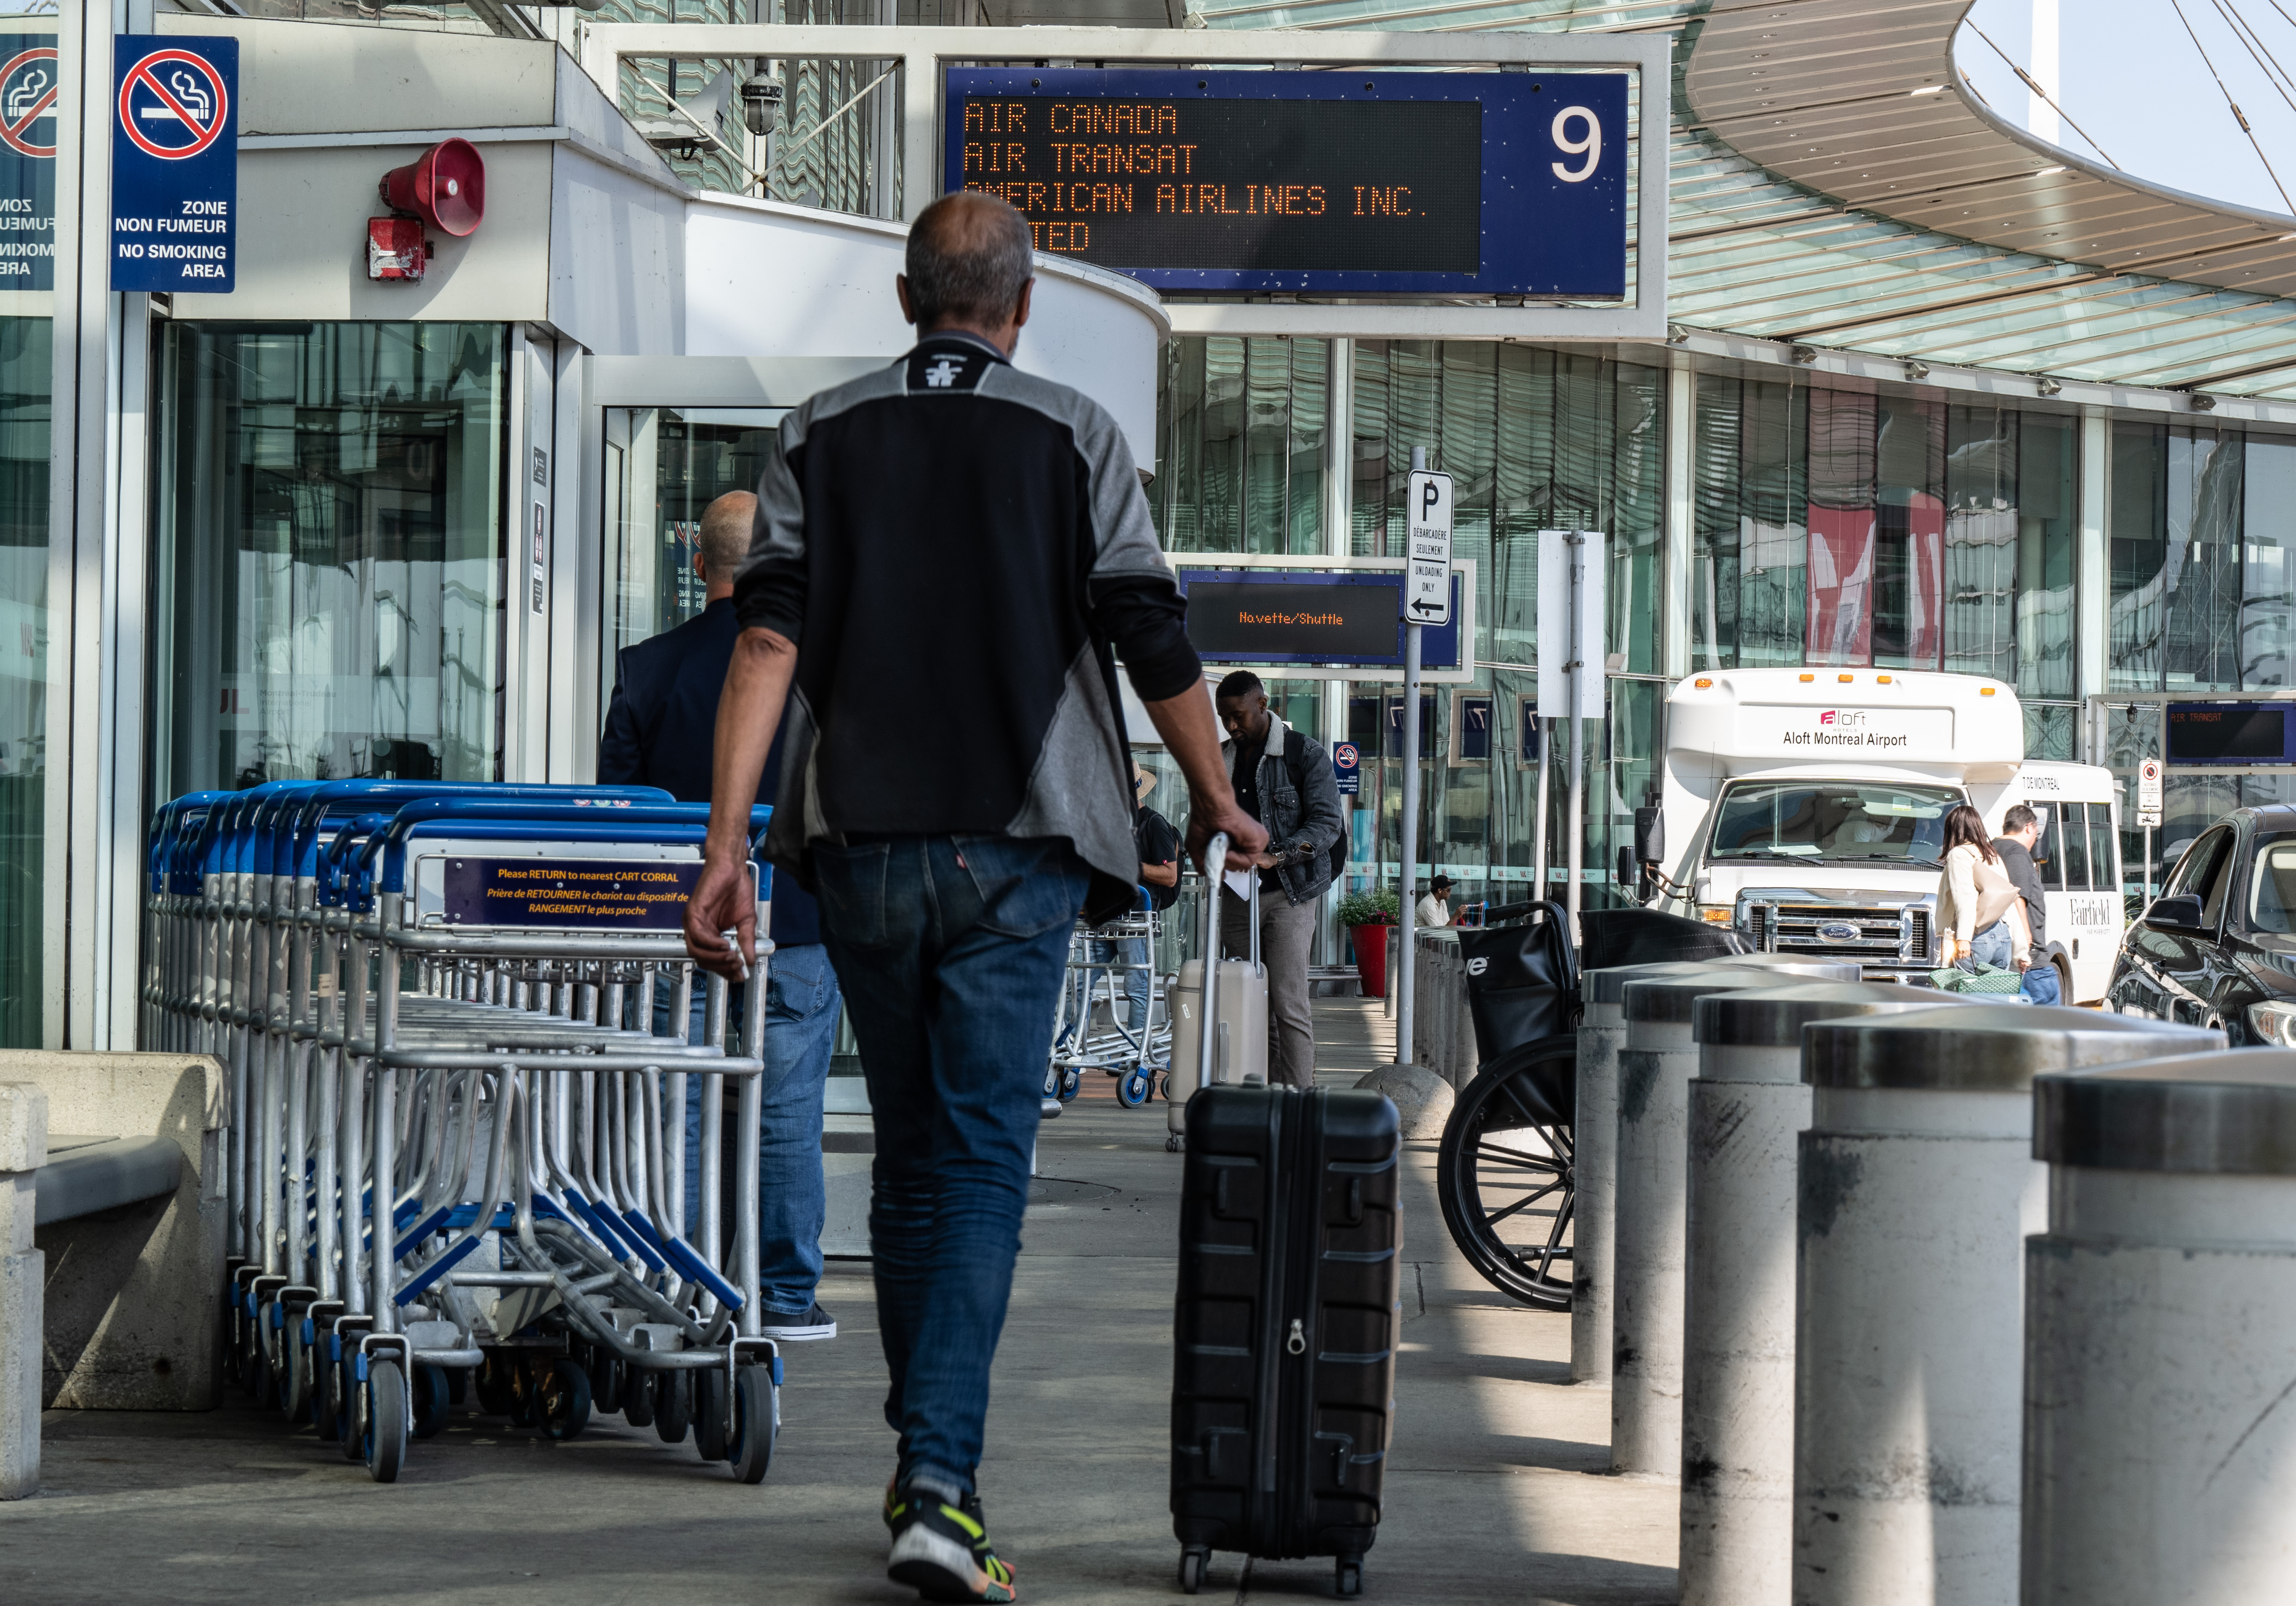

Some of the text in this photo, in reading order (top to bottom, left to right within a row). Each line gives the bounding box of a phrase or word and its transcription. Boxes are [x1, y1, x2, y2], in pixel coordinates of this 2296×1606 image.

[965, 103, 1176, 133] AIR CANADA
[1552, 106, 1601, 182] 9
[965, 143, 1197, 173] AIR TRANSAT
[1157, 184, 1325, 214] AIRLINES
[1353, 187, 1425, 215] INC.
[182, 201, 227, 215] ZONE
[116, 218, 226, 233] NON FUMEUR
[1028, 222, 1088, 251] TED
[119, 244, 226, 259] NO SMOKING
[182, 264, 225, 278] AREA
[1423, 482, 1439, 521] P
[1414, 525, 1447, 540] DÉBARCADÈRE
[1416, 544, 1443, 555] SEULEMENT
[1415, 565, 1442, 577] UNLOADING
[1422, 582, 1434, 592] ONLY
[1240, 612, 1342, 625] Navette/Shuttle
[1821, 710, 1866, 725] aloft
[2171, 713, 2222, 722] AIR TRANSAT
[1784, 732, 1906, 748] Aloft Montreal Airport
[2027, 777, 2033, 789] DE
[498, 869, 527, 878] Please
[529, 870, 566, 879] RETURN
[580, 872, 613, 880] nearest
[615, 872, 639, 881] CART
[641, 873, 678, 882] CORRAL
[487, 889, 513, 898] Prière
[515, 889, 525, 898] de
[527, 890, 581, 899] RETOURNER
[582, 891, 590, 899] le
[591, 892, 622, 900] chariot
[637, 892, 677, 902] dispositif
[677, 893, 688, 902] de
[529, 904, 647, 916] RANGEMENT le plus proche
[2070, 899, 2110, 925] Fairfield
[1829, 928, 1848, 936] Ford
